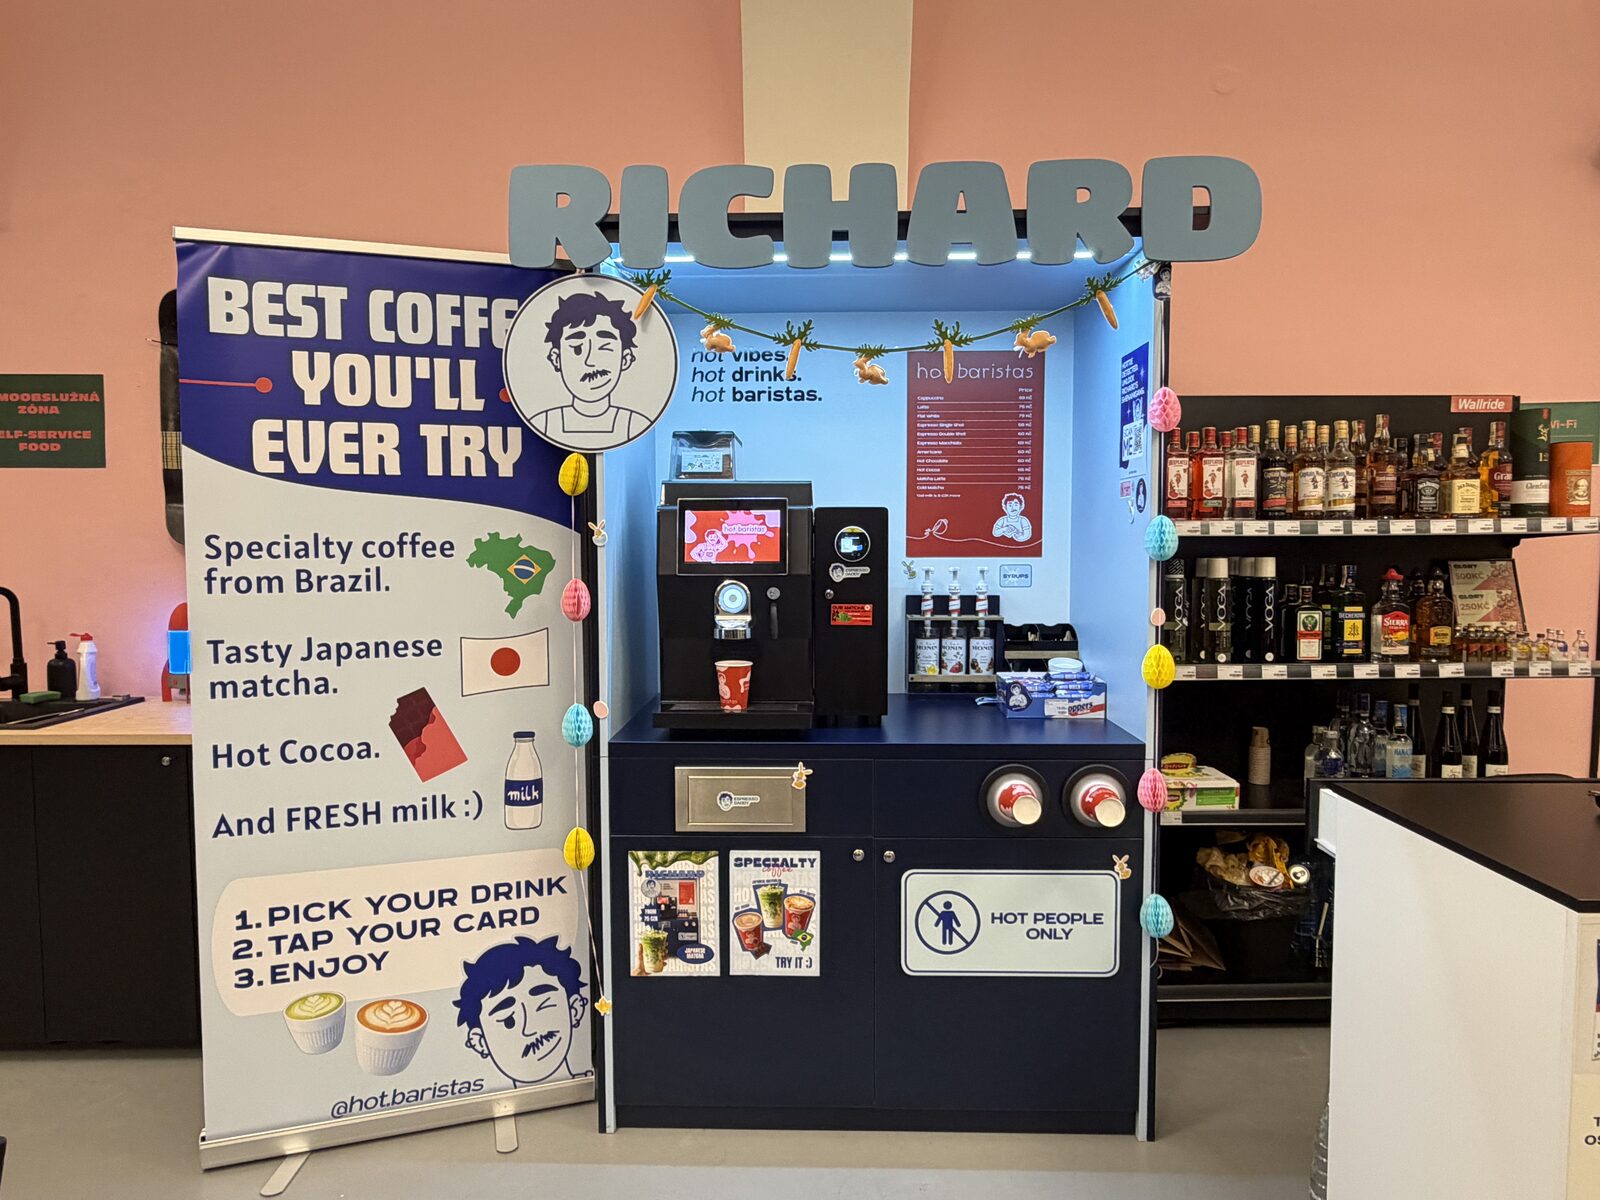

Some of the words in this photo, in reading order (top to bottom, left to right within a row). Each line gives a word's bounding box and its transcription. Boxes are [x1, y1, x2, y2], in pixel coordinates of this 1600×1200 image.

[508, 155, 1262, 269] RICHARD
[207, 276, 348, 340] BEST
[369, 289, 519, 349] COFFE
[291, 350, 485, 411] YOU'LL
[691, 367, 726, 382] hot
[917, 362, 942, 379] ho
[957, 363, 1034, 379] baristas
[17, 404, 60, 414] ZÓNA
[691, 386, 726, 402] hot
[732, 386, 822, 402] baristas.
[1458, 399, 1505, 410] Wallride
[18, 442, 61, 451] FOOD
[252, 418, 401, 476] EVER
[419, 423, 523, 477] TRY
[204, 532, 353, 566] Specialty
[361, 532, 455, 559] coffee
[204, 567, 284, 594] from
[295, 566, 391, 593] Brazil.
[1174, 585, 1184, 631] VOGA
[1217, 584, 1227, 631] VOGA
[1264, 584, 1275, 632] VOGA
[206, 639, 292, 668] Tasty
[300, 636, 443, 667] Japanese
[209, 669, 338, 700] matcha.
[1068, 702, 1093, 713] oppers
[212, 743, 271, 769] Hot
[279, 739, 380, 765] Cocoa.
[507, 785, 539, 801] milk
[211, 808, 275, 839] And
[286, 801, 381, 832] FRESH
[392, 793, 456, 823] milk
[733, 857, 817, 868] SPECIALTY
[364, 888, 458, 915] YOUR
[471, 875, 567, 905] DRINK
[346, 917, 441, 946] YOUR
[453, 906, 541, 933] CARD
[991, 912, 1028, 924] HOT
[1033, 912, 1104, 925] PEOPLE
[1026, 928, 1073, 940] ONLY
[775, 957, 792, 969] TRY
[795, 957, 804, 969] IT
[331, 1078, 485, 1119] @hot.baristas
